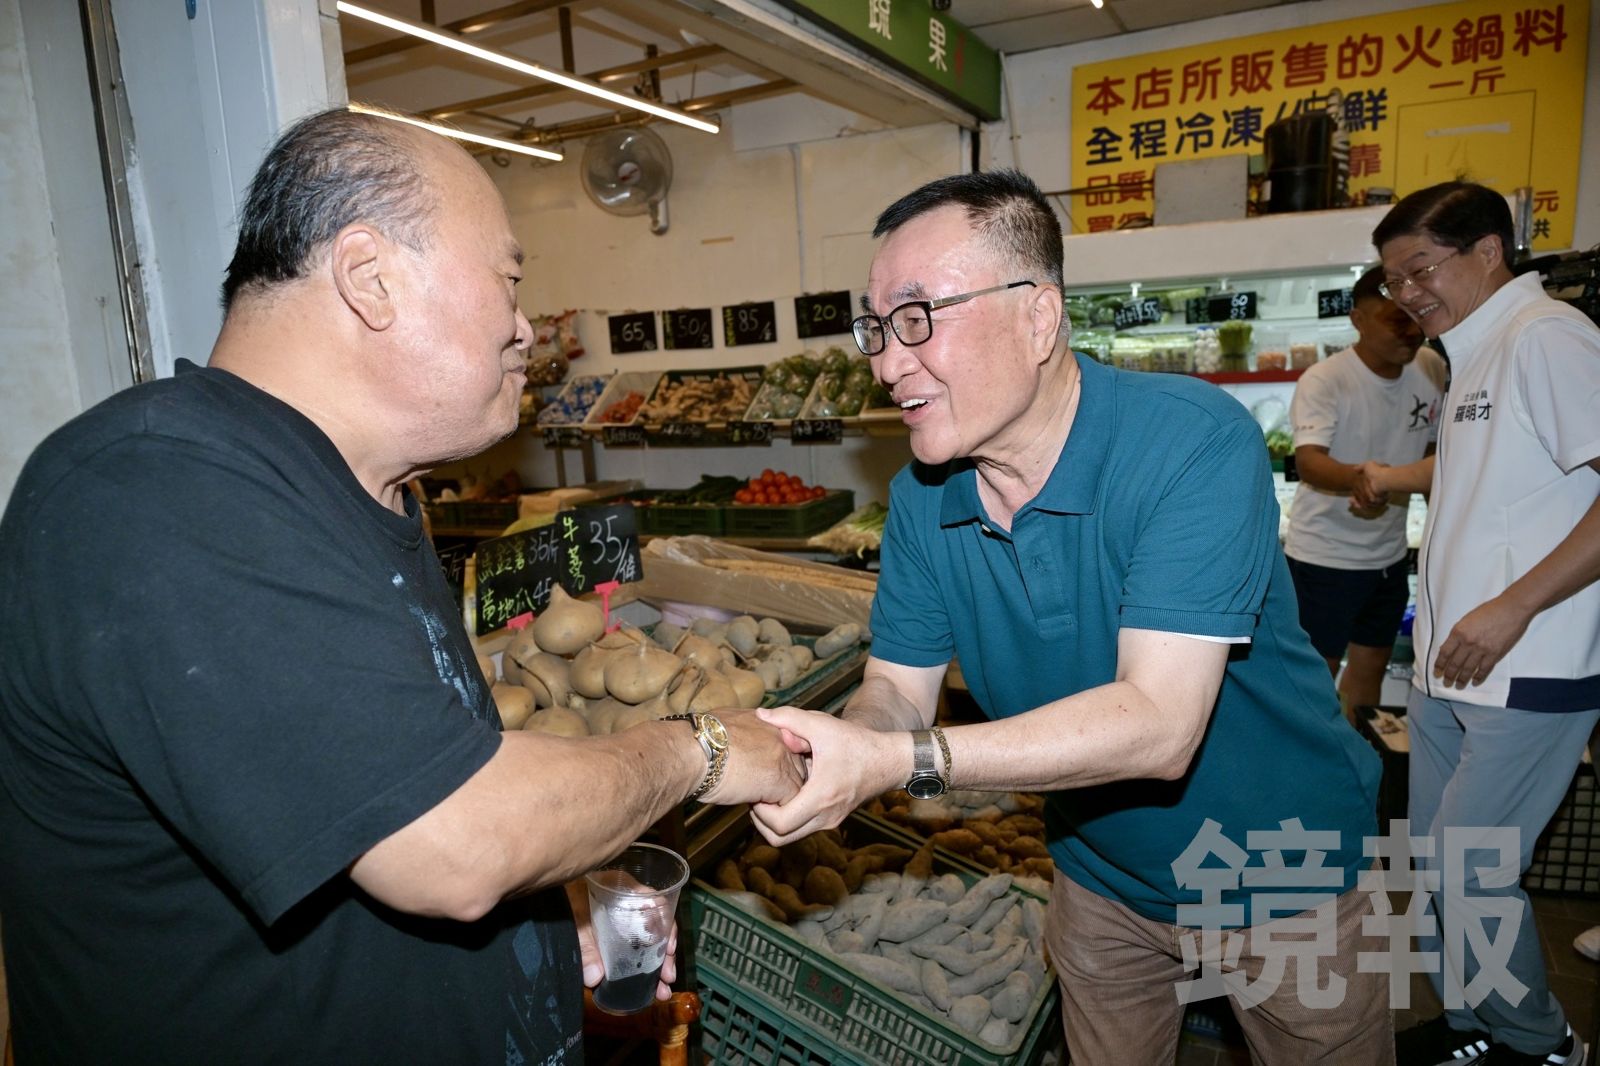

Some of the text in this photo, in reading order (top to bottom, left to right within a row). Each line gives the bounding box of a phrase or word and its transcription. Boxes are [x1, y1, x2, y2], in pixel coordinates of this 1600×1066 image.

[1086, 4, 1568, 116] 本店所販售的火鍋料
[1429, 66, 1506, 96] 一斤
[1533, 190, 1560, 214] 元
[813, 303, 837, 322] 20
[621, 321, 645, 342] 65
[1453, 402, 1494, 423] 羅明才
